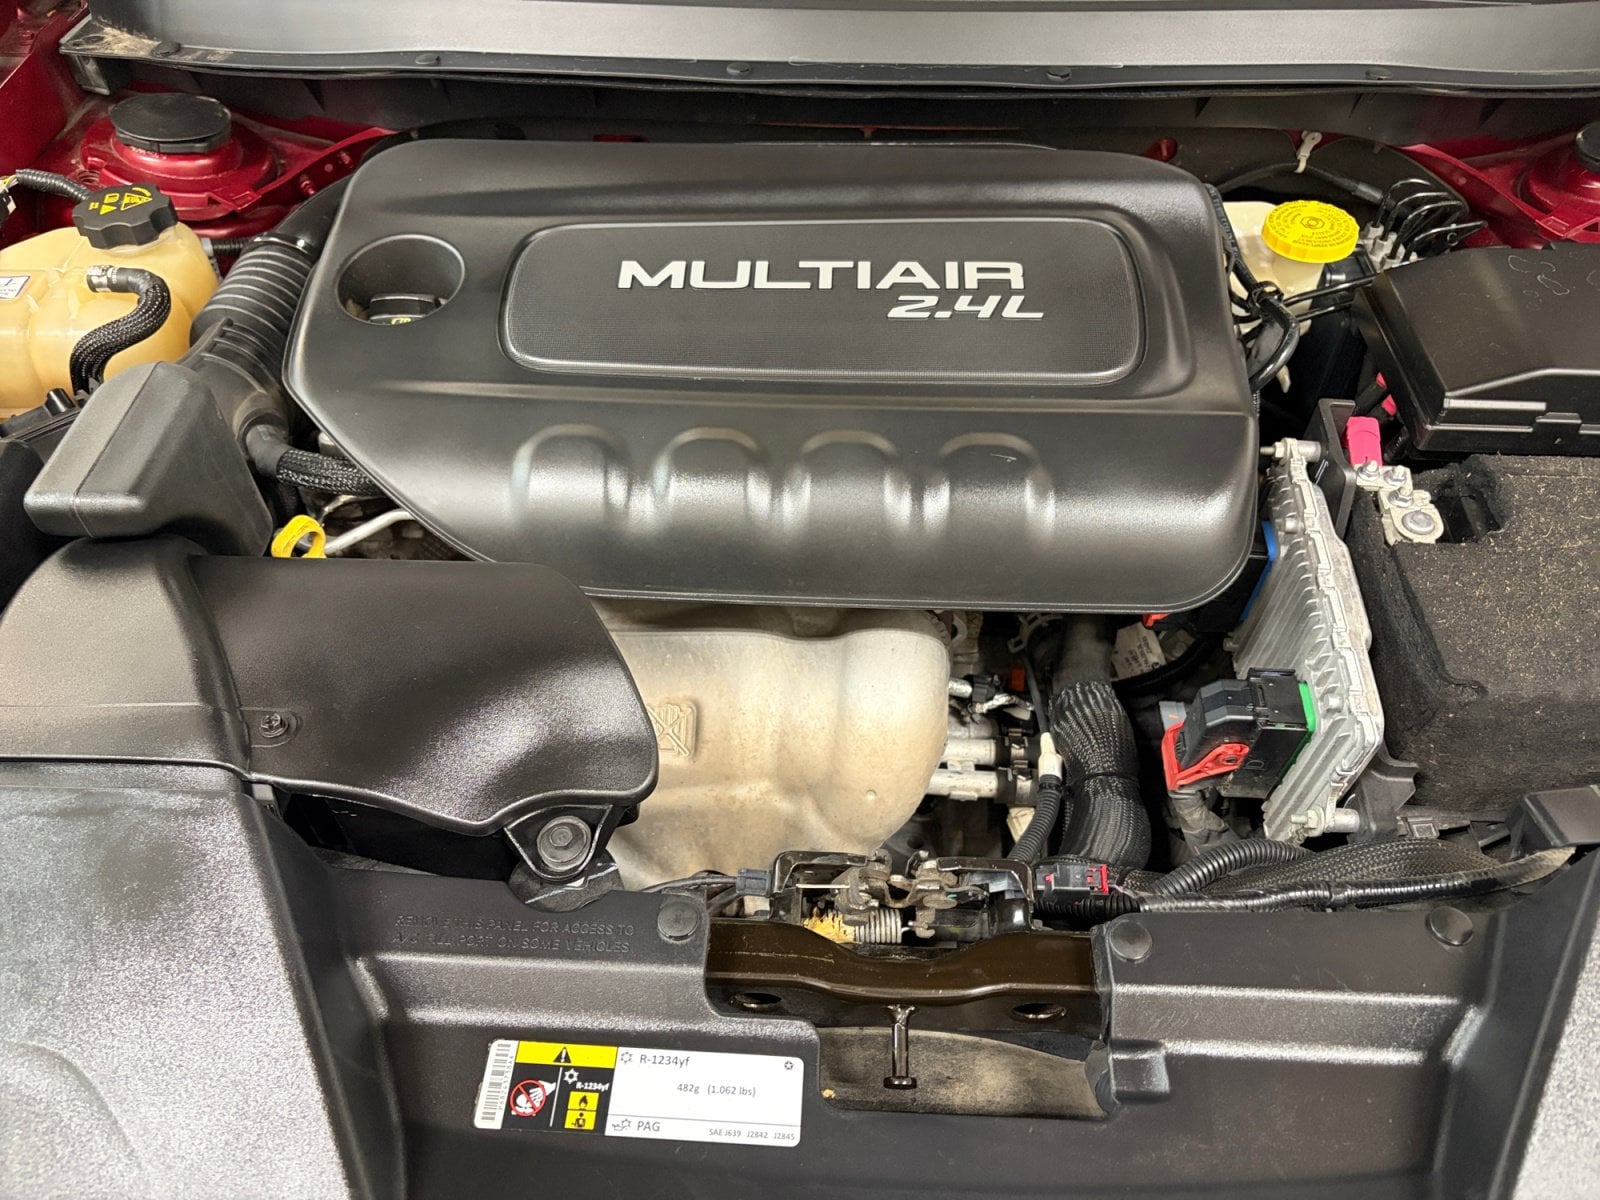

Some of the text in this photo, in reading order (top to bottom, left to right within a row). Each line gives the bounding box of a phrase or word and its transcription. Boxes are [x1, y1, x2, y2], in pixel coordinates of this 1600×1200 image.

[618, 261, 1026, 290] MULTIAIR
[888, 295, 1045, 319] 2.4L
[486, 918, 528, 932] PANEL
[532, 920, 558, 933] FOR
[561, 922, 615, 936] ACCESS
[618, 923, 635, 937] TO
[456, 934, 494, 947] PORT
[521, 937, 561, 950] SOME
[565, 939, 631, 953] VEHICLES
[639, 1053, 691, 1069] R-1234yf
[676, 1083, 757, 1098] 482g (1.062 lbs)
[637, 1120, 661, 1132] PAG
[708, 1128, 724, 1137] SAE
